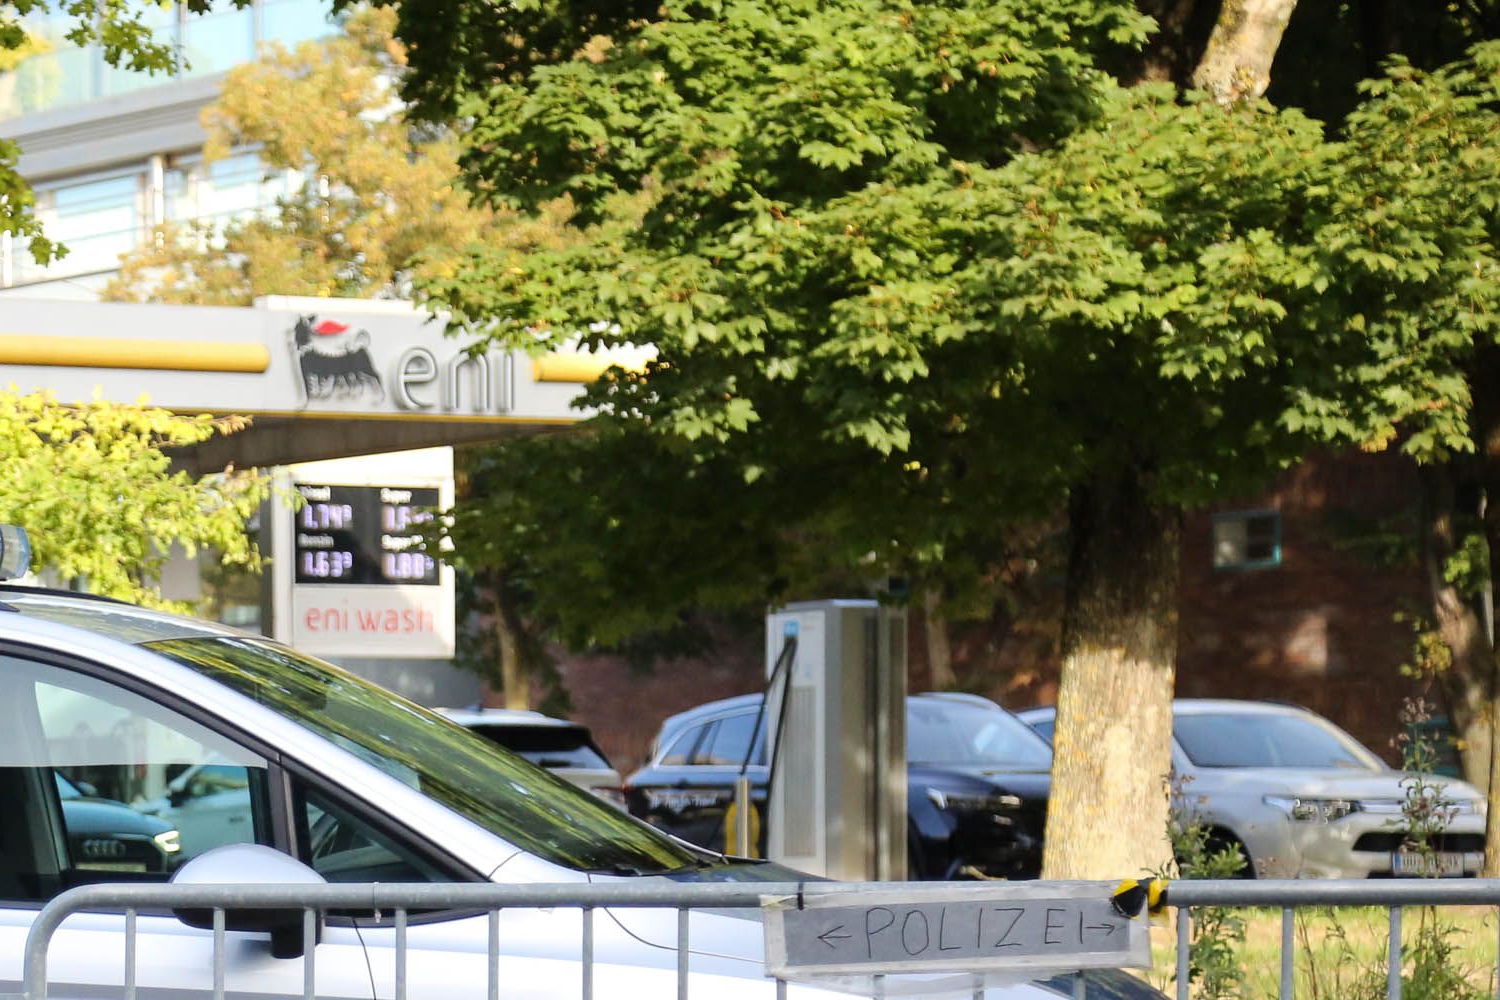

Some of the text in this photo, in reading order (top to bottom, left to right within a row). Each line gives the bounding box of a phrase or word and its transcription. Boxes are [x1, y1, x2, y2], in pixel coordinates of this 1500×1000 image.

[394, 346, 515, 412] eni
[304, 598, 434, 634] eni wash
[865, 907, 1084, 959] POLIZEI
